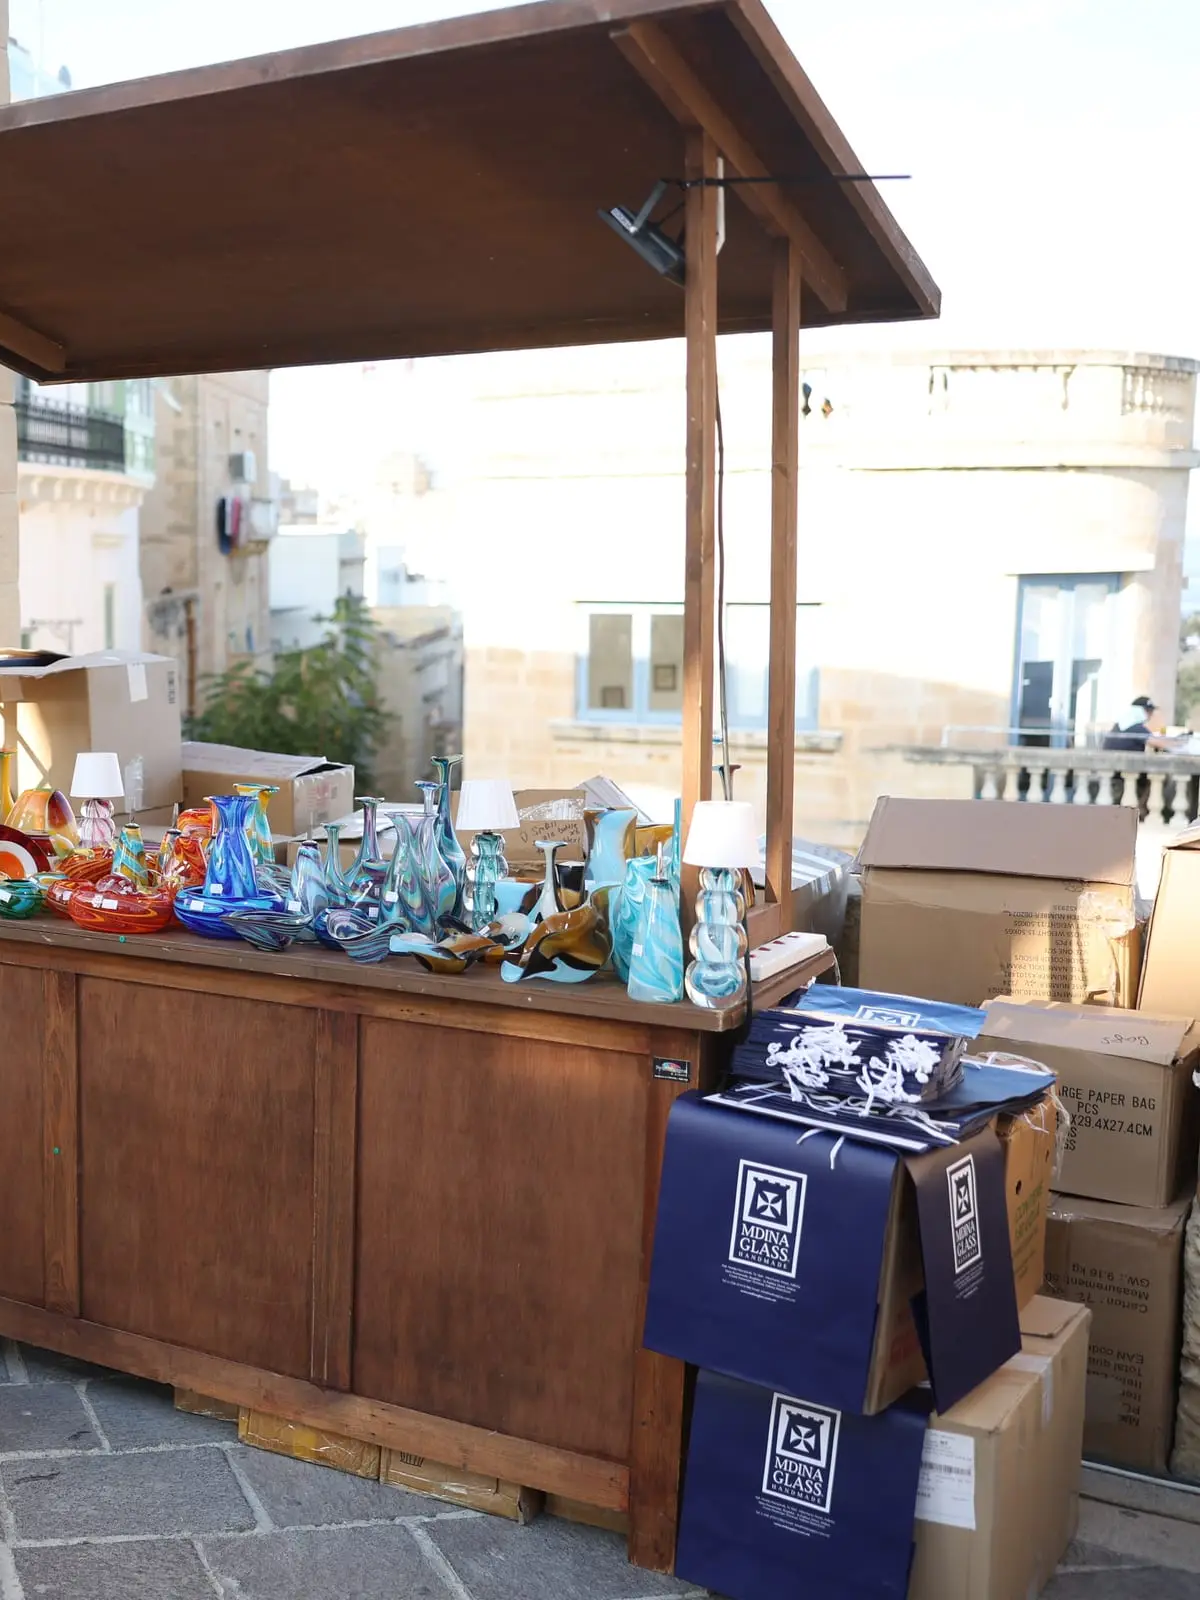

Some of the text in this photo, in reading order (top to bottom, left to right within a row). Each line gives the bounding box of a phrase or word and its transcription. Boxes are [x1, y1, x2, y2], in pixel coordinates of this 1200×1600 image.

[1077, 1101, 1099, 1116] PCS
[1088, 1089, 1125, 1106] PAPER
[1132, 1096, 1156, 1110] BAG
[741, 1223, 790, 1247] MDINA
[955, 1220, 976, 1243] MDINA
[739, 1236, 789, 1262] GLASS
[956, 1233, 977, 1258] GLASS
[738, 1250, 788, 1270] HANDMADE
[1071, 1263, 1086, 1277] kg
[1116, 1351, 1144, 1365] EAN
[1113, 1362, 1143, 1377] Total
[774, 1455, 824, 1483] MDINA
[771, 1483, 823, 1505] HANDMADE
[772, 1470, 823, 1497] GLASS
